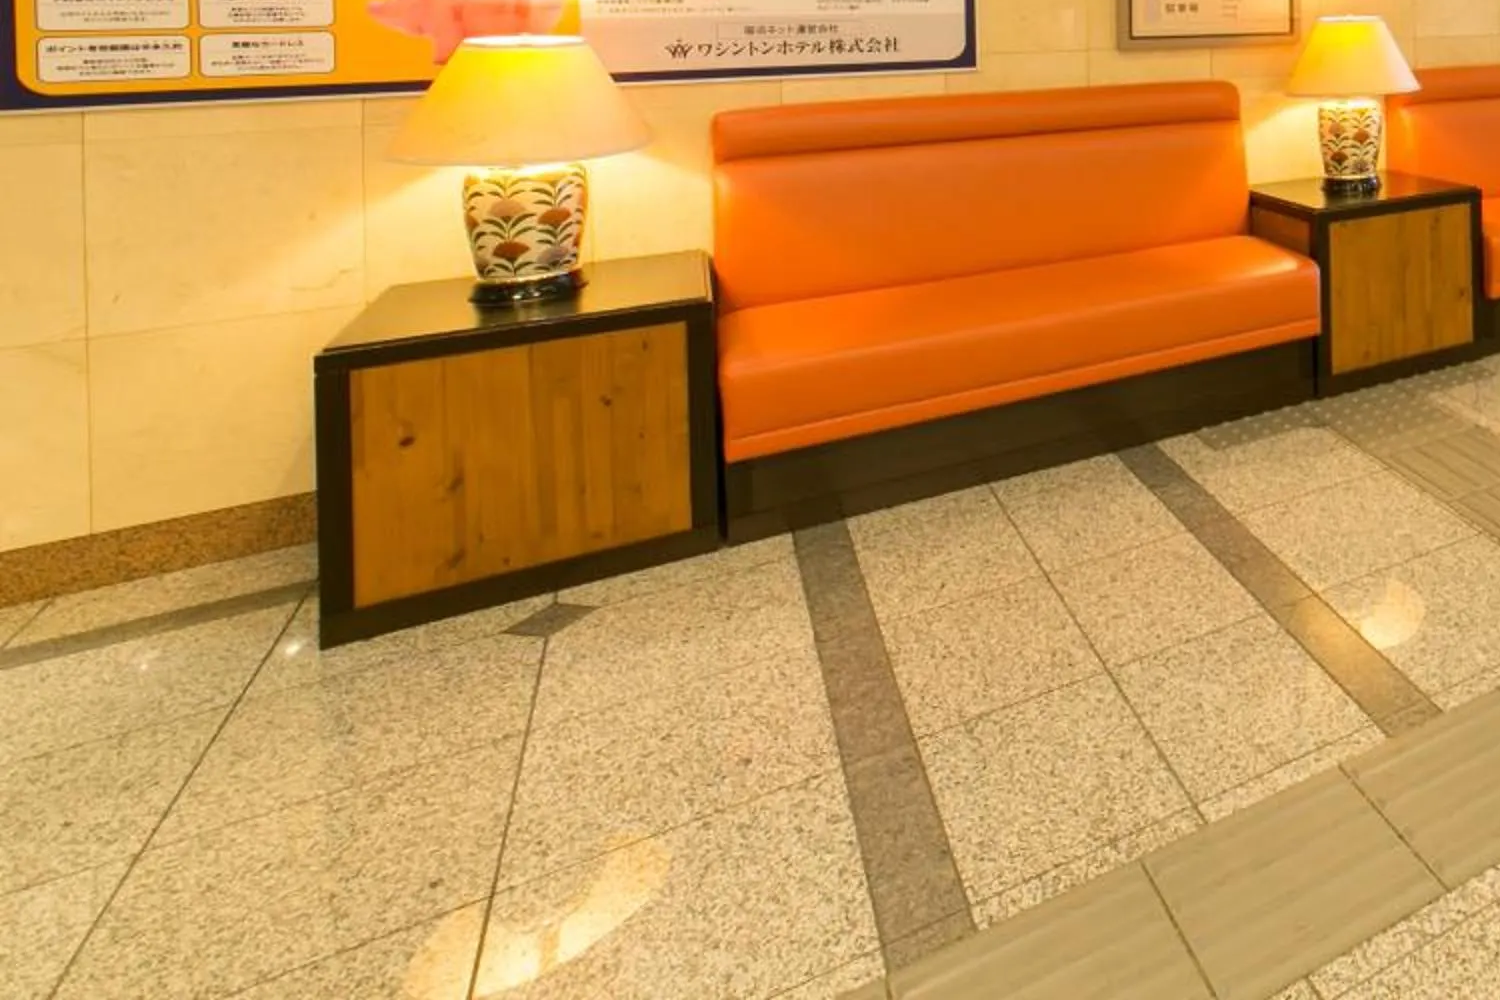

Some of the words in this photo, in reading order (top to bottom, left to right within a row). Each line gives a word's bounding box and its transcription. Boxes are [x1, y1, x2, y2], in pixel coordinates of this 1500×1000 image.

[697, 37, 898, 57] ワシントンホテル株式会社
